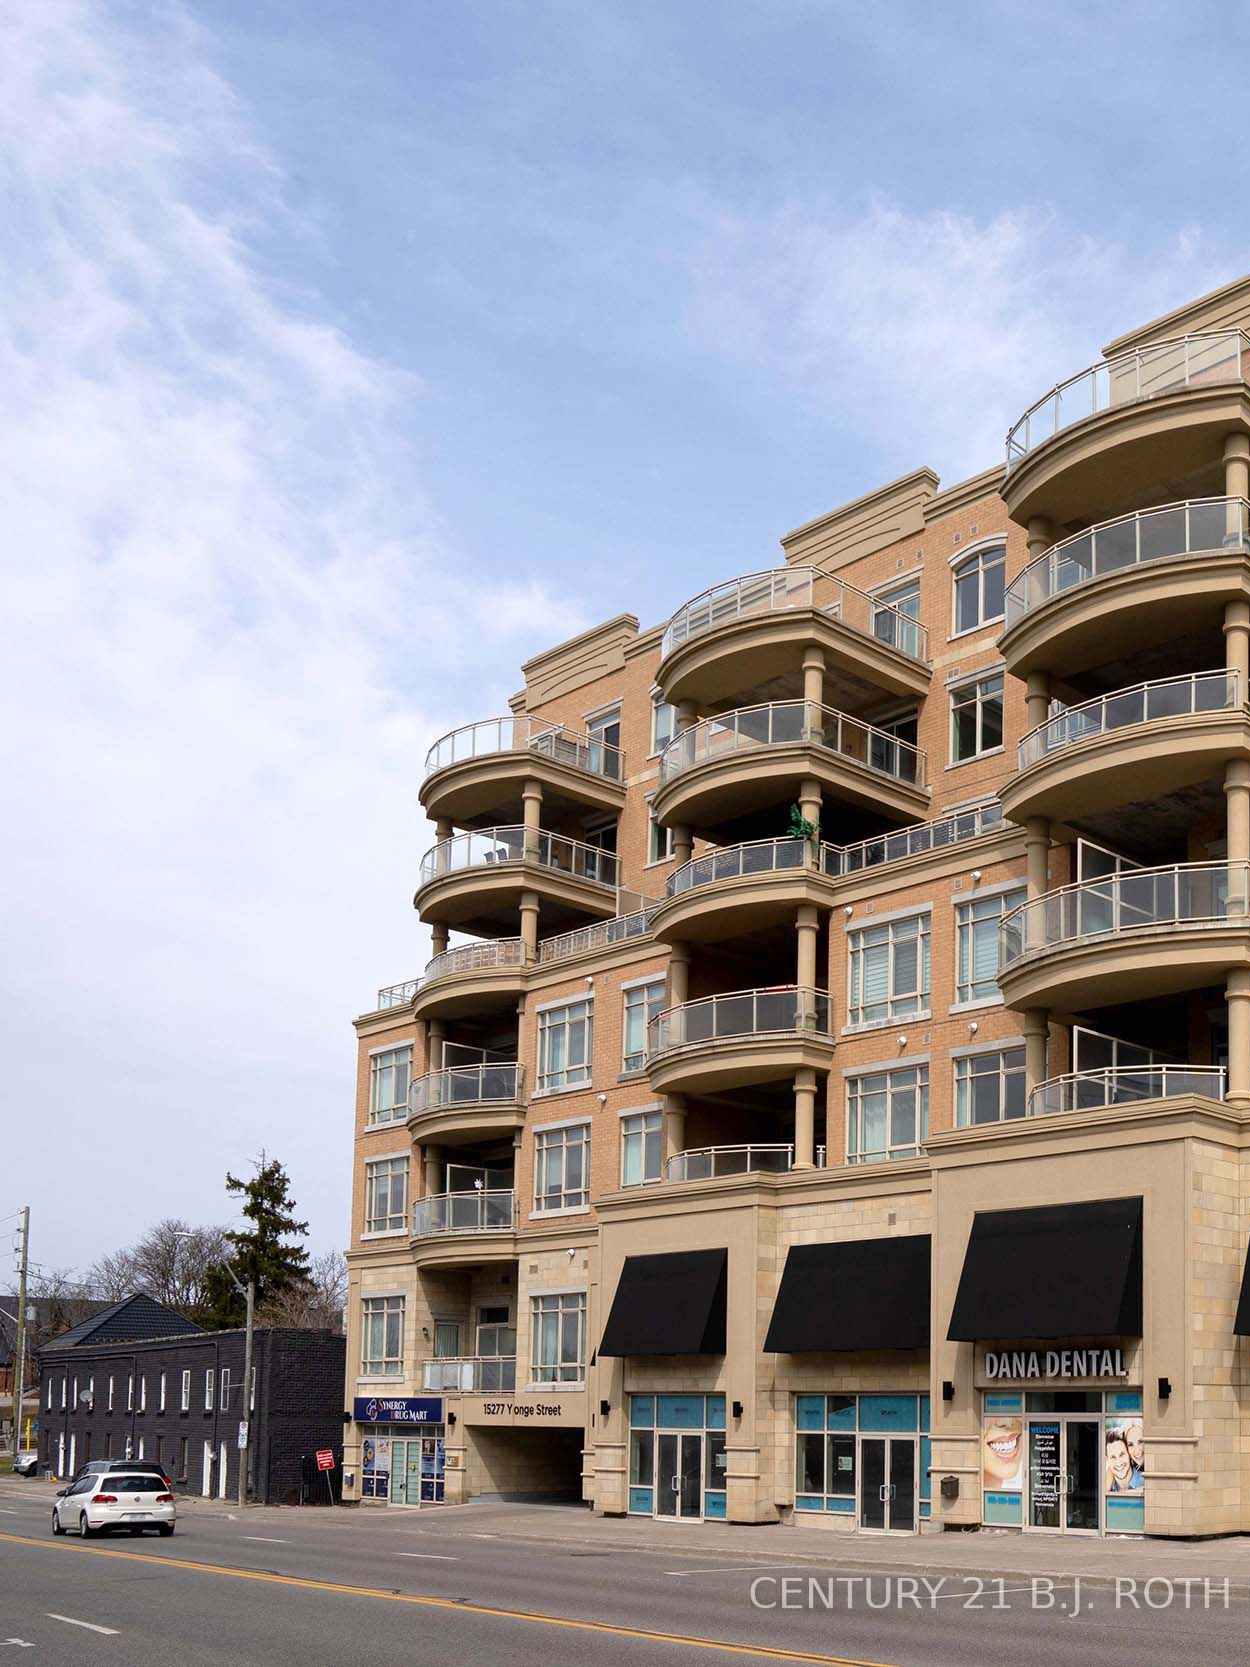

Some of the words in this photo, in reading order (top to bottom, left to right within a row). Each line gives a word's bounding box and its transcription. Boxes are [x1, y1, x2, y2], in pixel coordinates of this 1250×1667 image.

[985, 1351, 1040, 1378] DANA
[1046, 1349, 1127, 1377] DENTAL
[379, 1399, 408, 1412] SYNERGY
[483, 1403, 505, 1415] 15277
[536, 1404, 562, 1416] Street
[390, 1410, 409, 1420] DRUG
[409, 1410, 428, 1421] MART
[1031, 1426, 1060, 1434] WELCOME
